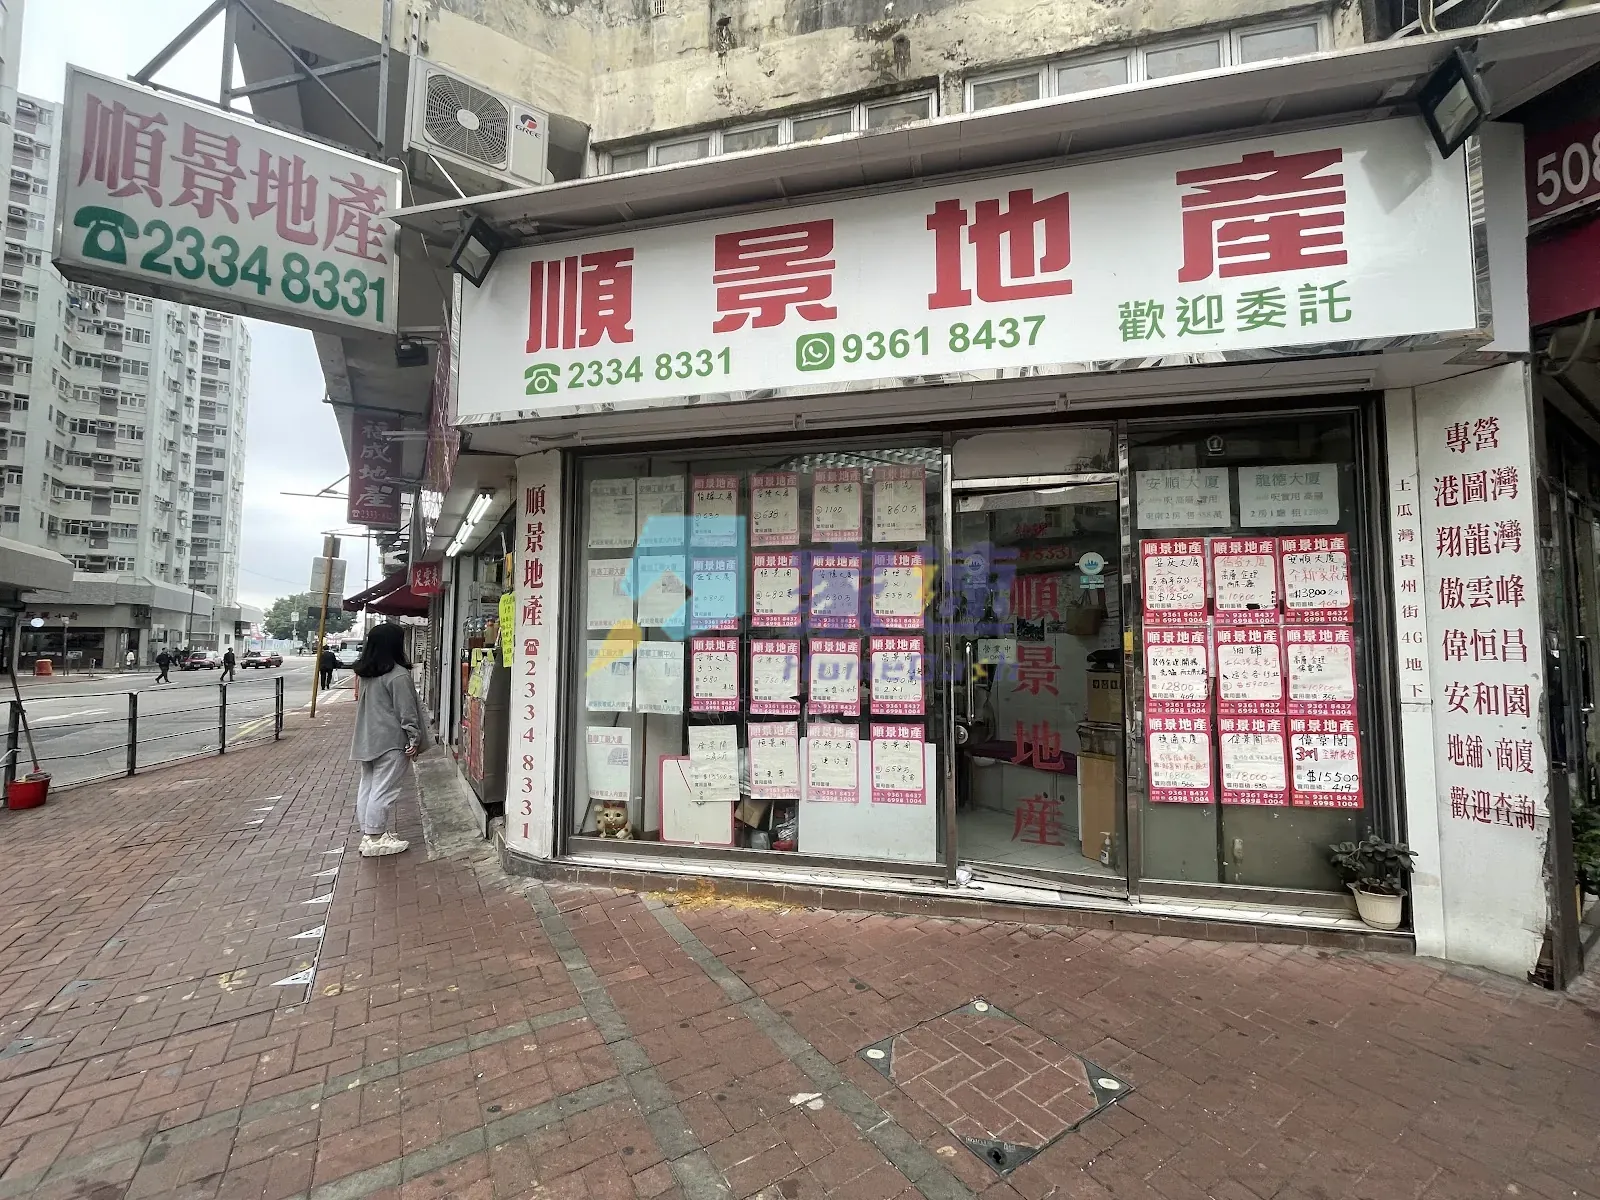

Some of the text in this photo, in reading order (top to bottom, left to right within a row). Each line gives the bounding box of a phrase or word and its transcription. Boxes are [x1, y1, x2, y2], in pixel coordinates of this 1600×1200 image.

[515, 125, 541, 139] GREE
[77, 92, 388, 265] 順景地產
[525, 147, 1348, 354] 順景地產
[139, 219, 385, 323] 2334 8331
[1117, 279, 1352, 342] 歡迎委託
[842, 314, 1046, 363] 9361 8437
[567, 346, 732, 389] 2334 8331
[1444, 416, 1500, 454] 專營
[1146, 475, 1220, 491] 安順大廈
[1255, 472, 1321, 488] 龍德大廈
[1433, 465, 1519, 507] 港圖灣
[1282, 538, 1346, 552] 順景地產
[1435, 519, 1522, 559] 翔龍灣
[1144, 542, 1202, 555] 順景地產
[1214, 541, 1273, 555] 順景地產
[521, 484, 546, 627] 順景地產
[754, 557, 800, 567] 順景地產
[813, 557, 860, 567] 順景地產
[874, 555, 923, 566] 順景地產
[1438, 573, 1526, 610] 傲雲峰
[1147, 631, 1205, 644] 順景地產
[1217, 630, 1277, 643] 順景地產
[1287, 630, 1350, 643] 順景地產
[694, 640, 737, 651] 順景地產
[753, 642, 798, 654] 順景地產
[811, 641, 858, 653] 順景地產
[872, 639, 921, 651] 順景地產
[1444, 681, 1532, 719] 安和園
[1149, 718, 1207, 731] 順景地產
[1220, 719, 1282, 732] 順景地產
[1291, 719, 1355, 733] 順景地產
[873, 727, 922, 739] 順景地產
[1307, 770, 1359, 783] $15500
[1450, 785, 1536, 831] 歡迎查詢
